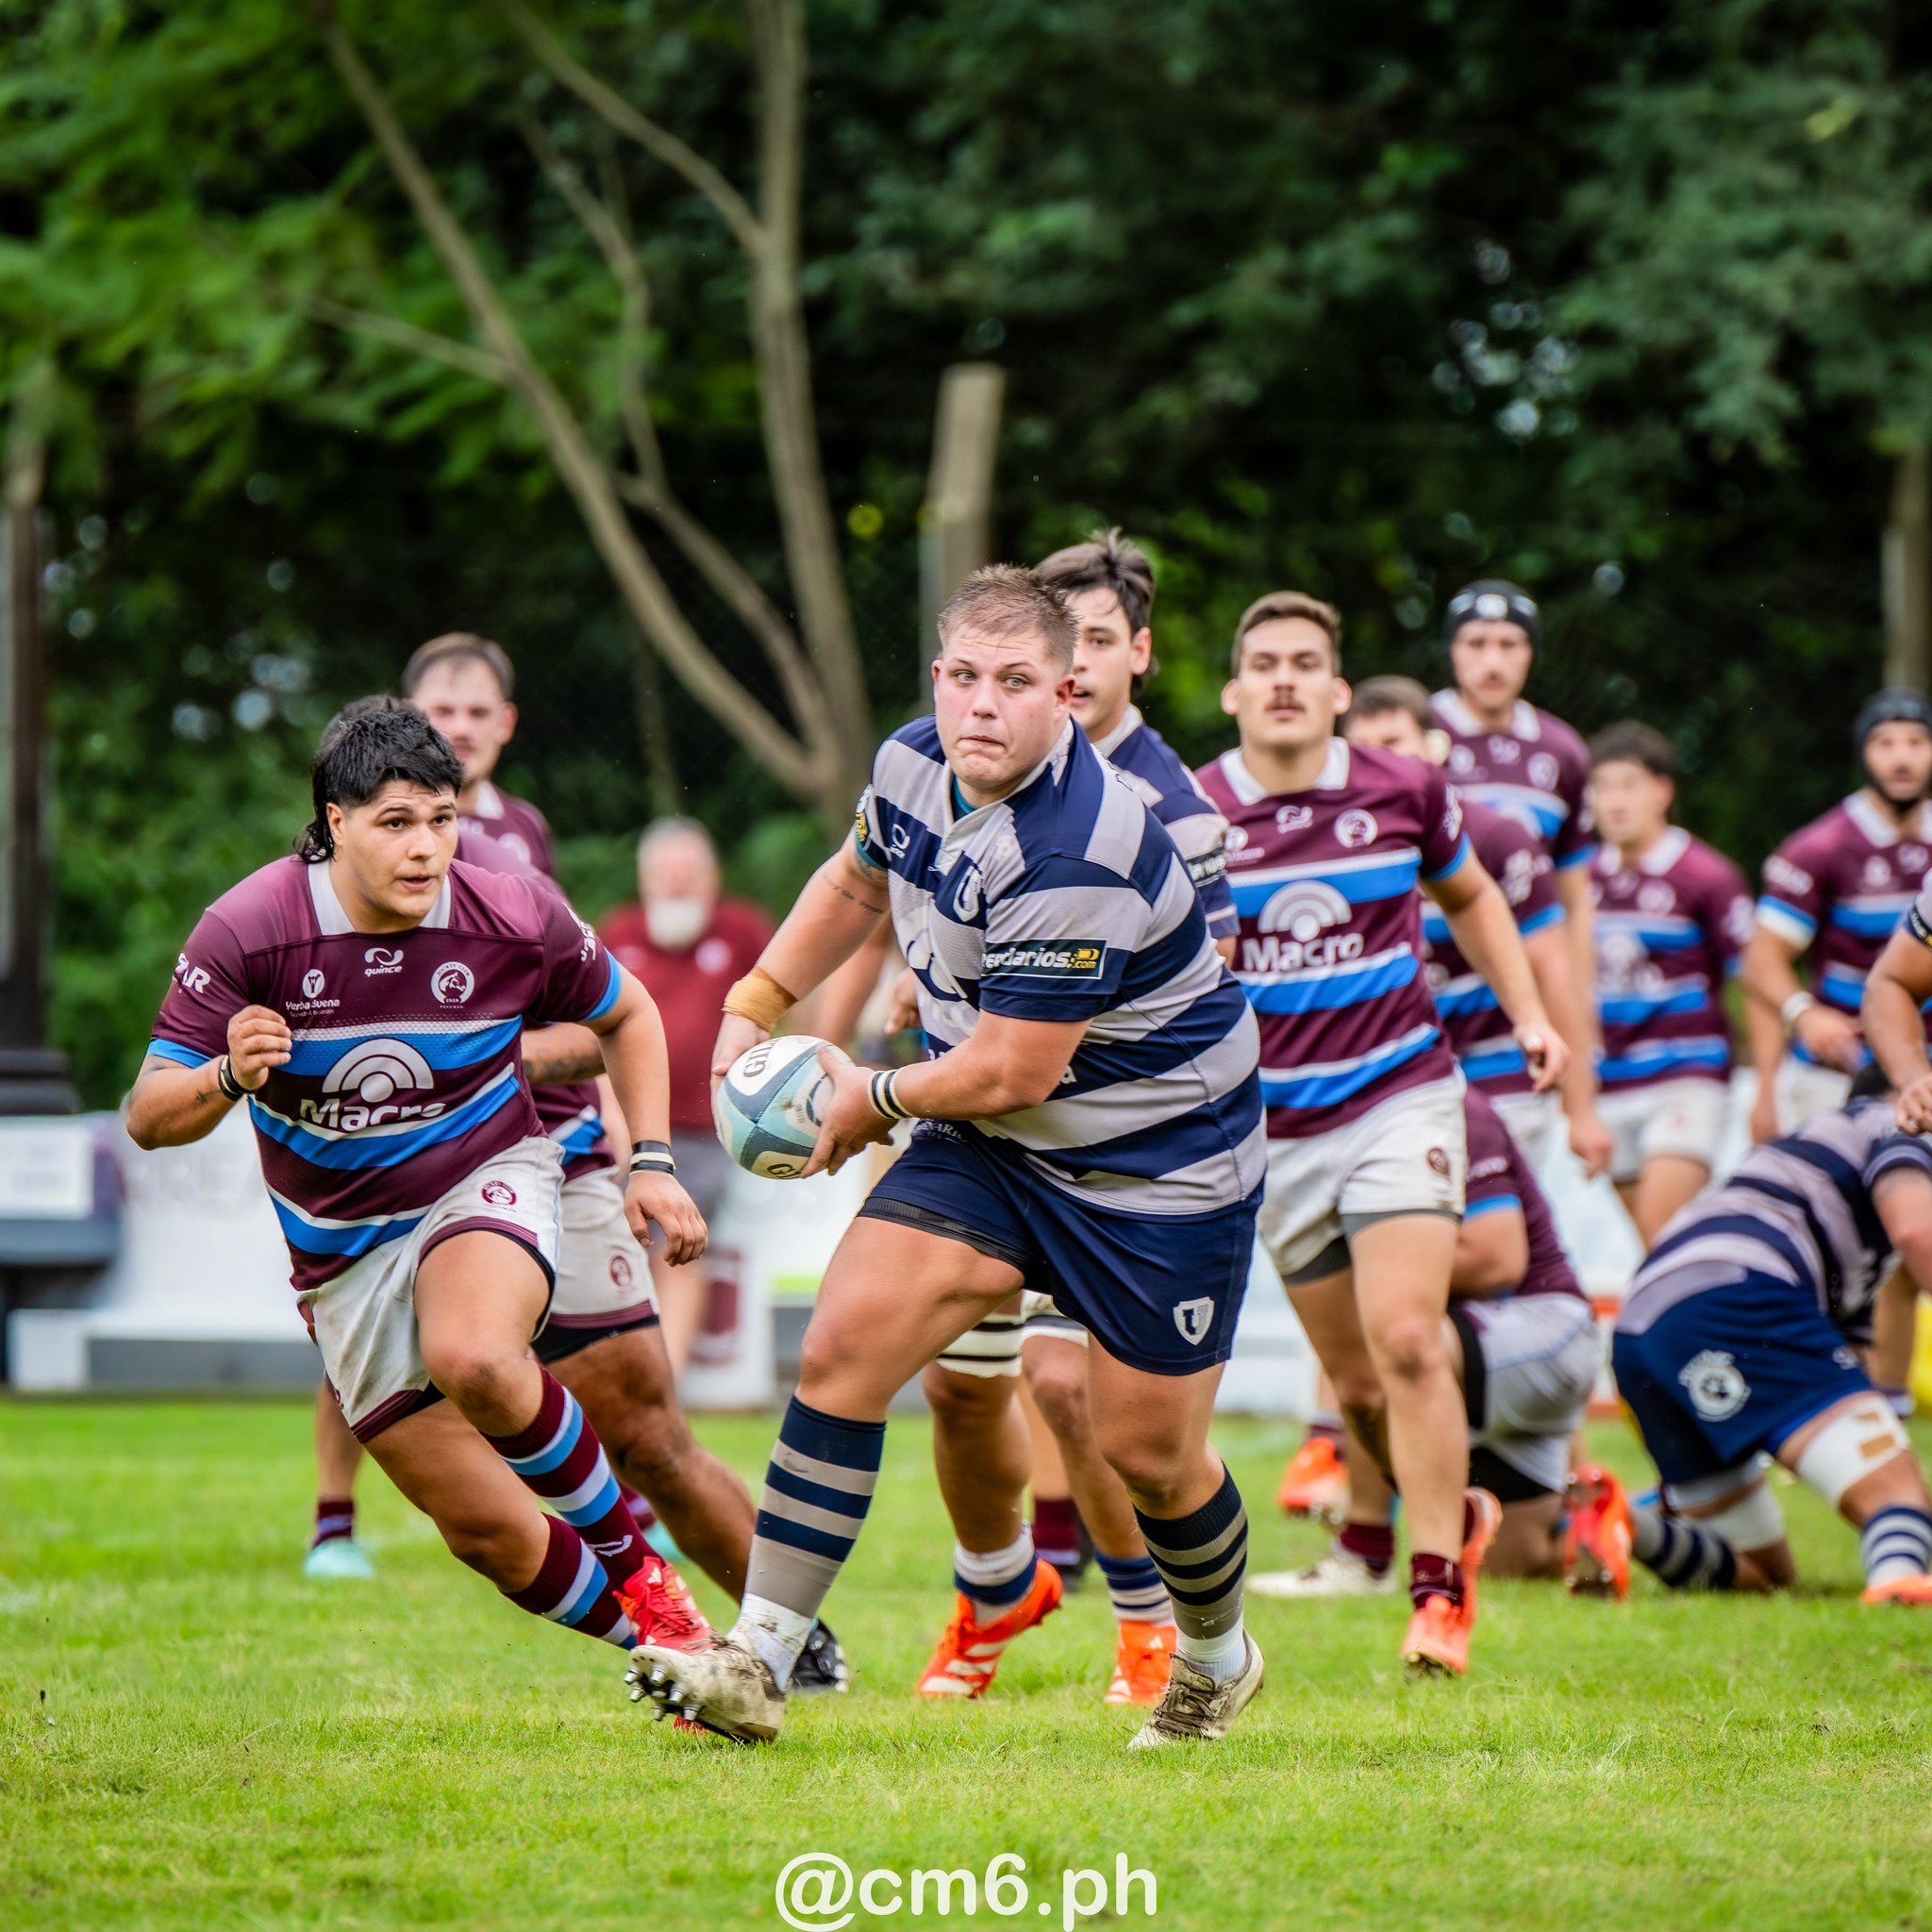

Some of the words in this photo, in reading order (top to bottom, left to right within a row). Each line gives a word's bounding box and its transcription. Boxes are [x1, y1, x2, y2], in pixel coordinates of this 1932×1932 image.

[1242, 933, 1364, 972] Macro
[364, 965, 403, 977] quince
[285, 1001, 310, 1010] Yerba
[310, 999, 341, 1008] Buena
[299, 1098, 446, 1132] Macro
